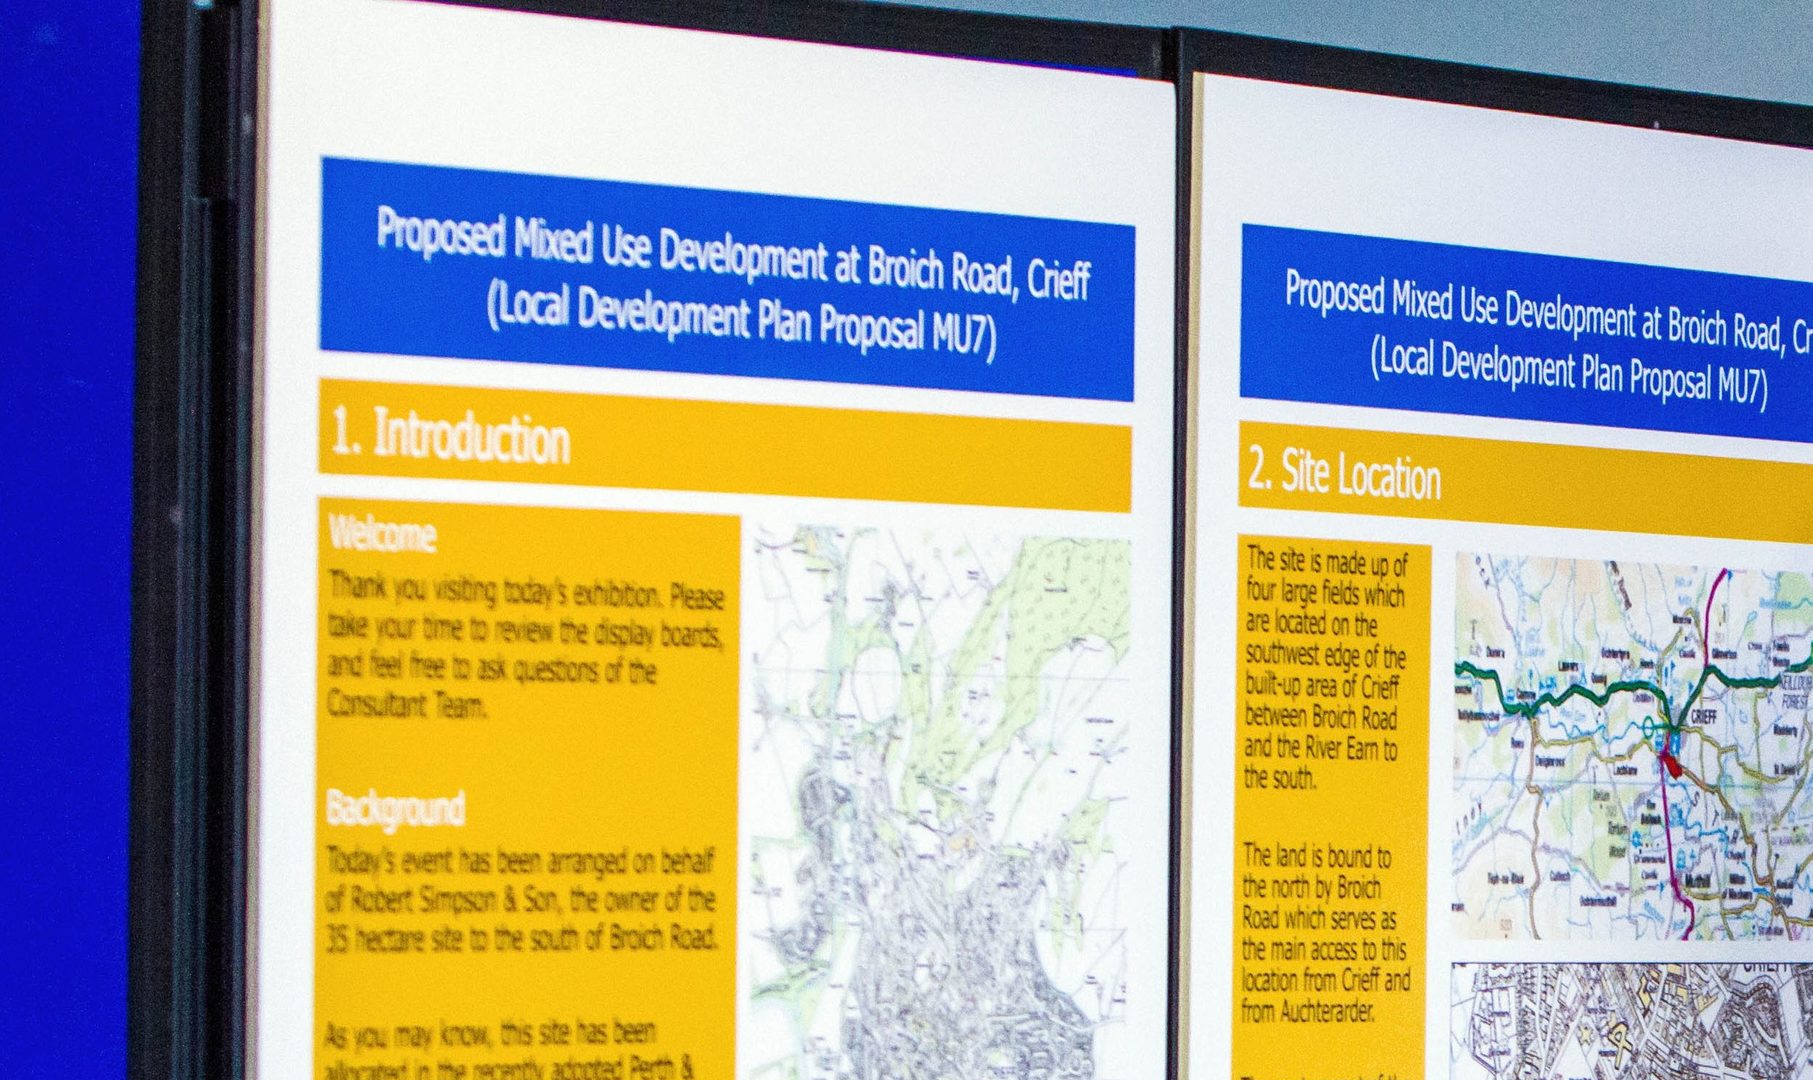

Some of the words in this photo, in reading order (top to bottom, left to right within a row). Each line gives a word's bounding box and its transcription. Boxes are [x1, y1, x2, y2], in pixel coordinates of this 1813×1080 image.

[378, 204, 507, 262] Proposed
[514, 215, 594, 263] Mixed
[601, 221, 652, 268] Use
[659, 226, 828, 287] Development
[835, 244, 860, 284] at
[868, 242, 944, 290] Broich
[952, 248, 1017, 302] Road,
[1027, 254, 1092, 302] Crieff
[488, 282, 570, 337] (Local
[578, 288, 750, 347] Development
[758, 298, 812, 344] Plan
[819, 301, 925, 358] Proposal
[932, 308, 997, 365] MU7)
[1286, 265, 1386, 322] Proposed
[1392, 275, 1454, 321] Mixed
[1460, 281, 1499, 325] Use
[1505, 285, 1636, 344] Development
[1642, 302, 1661, 340] at
[1668, 300, 1727, 346] Broich
[1733, 306, 1784, 358] Road,
[1371, 332, 1435, 385] (Local
[1441, 338, 1575, 396] Development
[1581, 348, 1623, 392] Plan
[1630, 352, 1712, 408] Proposal
[1718, 359, 1767, 416] MU7)
[331, 411, 360, 455] 1.
[374, 413, 571, 465] Introduction
[1248, 447, 1271, 489] 2.
[1282, 449, 1331, 493] Site
[1337, 453, 1442, 500] Location
[328, 517, 437, 555] Welcome
[1247, 544, 1276, 572] The
[1280, 547, 1306, 574] site
[1310, 548, 1322, 574] is
[1326, 549, 1367, 576] made
[1370, 556, 1390, 583] up
[1393, 551, 1409, 578] of
[1246, 574, 1276, 602] four
[1281, 576, 1318, 610] large
[1322, 578, 1360, 607] fields
[1364, 581, 1406, 609] which
[1246, 611, 1271, 633] are
[1274, 607, 1328, 636] located
[1331, 615, 1350, 637] on
[1354, 610, 1378, 638] the
[1245, 669, 1302, 703] built-up
[1306, 676, 1338, 699] area
[1342, 672, 1357, 699] of
[1361, 673, 1400, 701] Crieff
[325, 790, 466, 833] Background
[1242, 965, 1299, 993] location
[1303, 965, 1337, 993] from
[1341, 965, 1380, 993] Crieff
[1384, 965, 1412, 993] and
[1241, 996, 1276, 1023] from
[1280, 996, 1375, 1023] Auchterarder.
